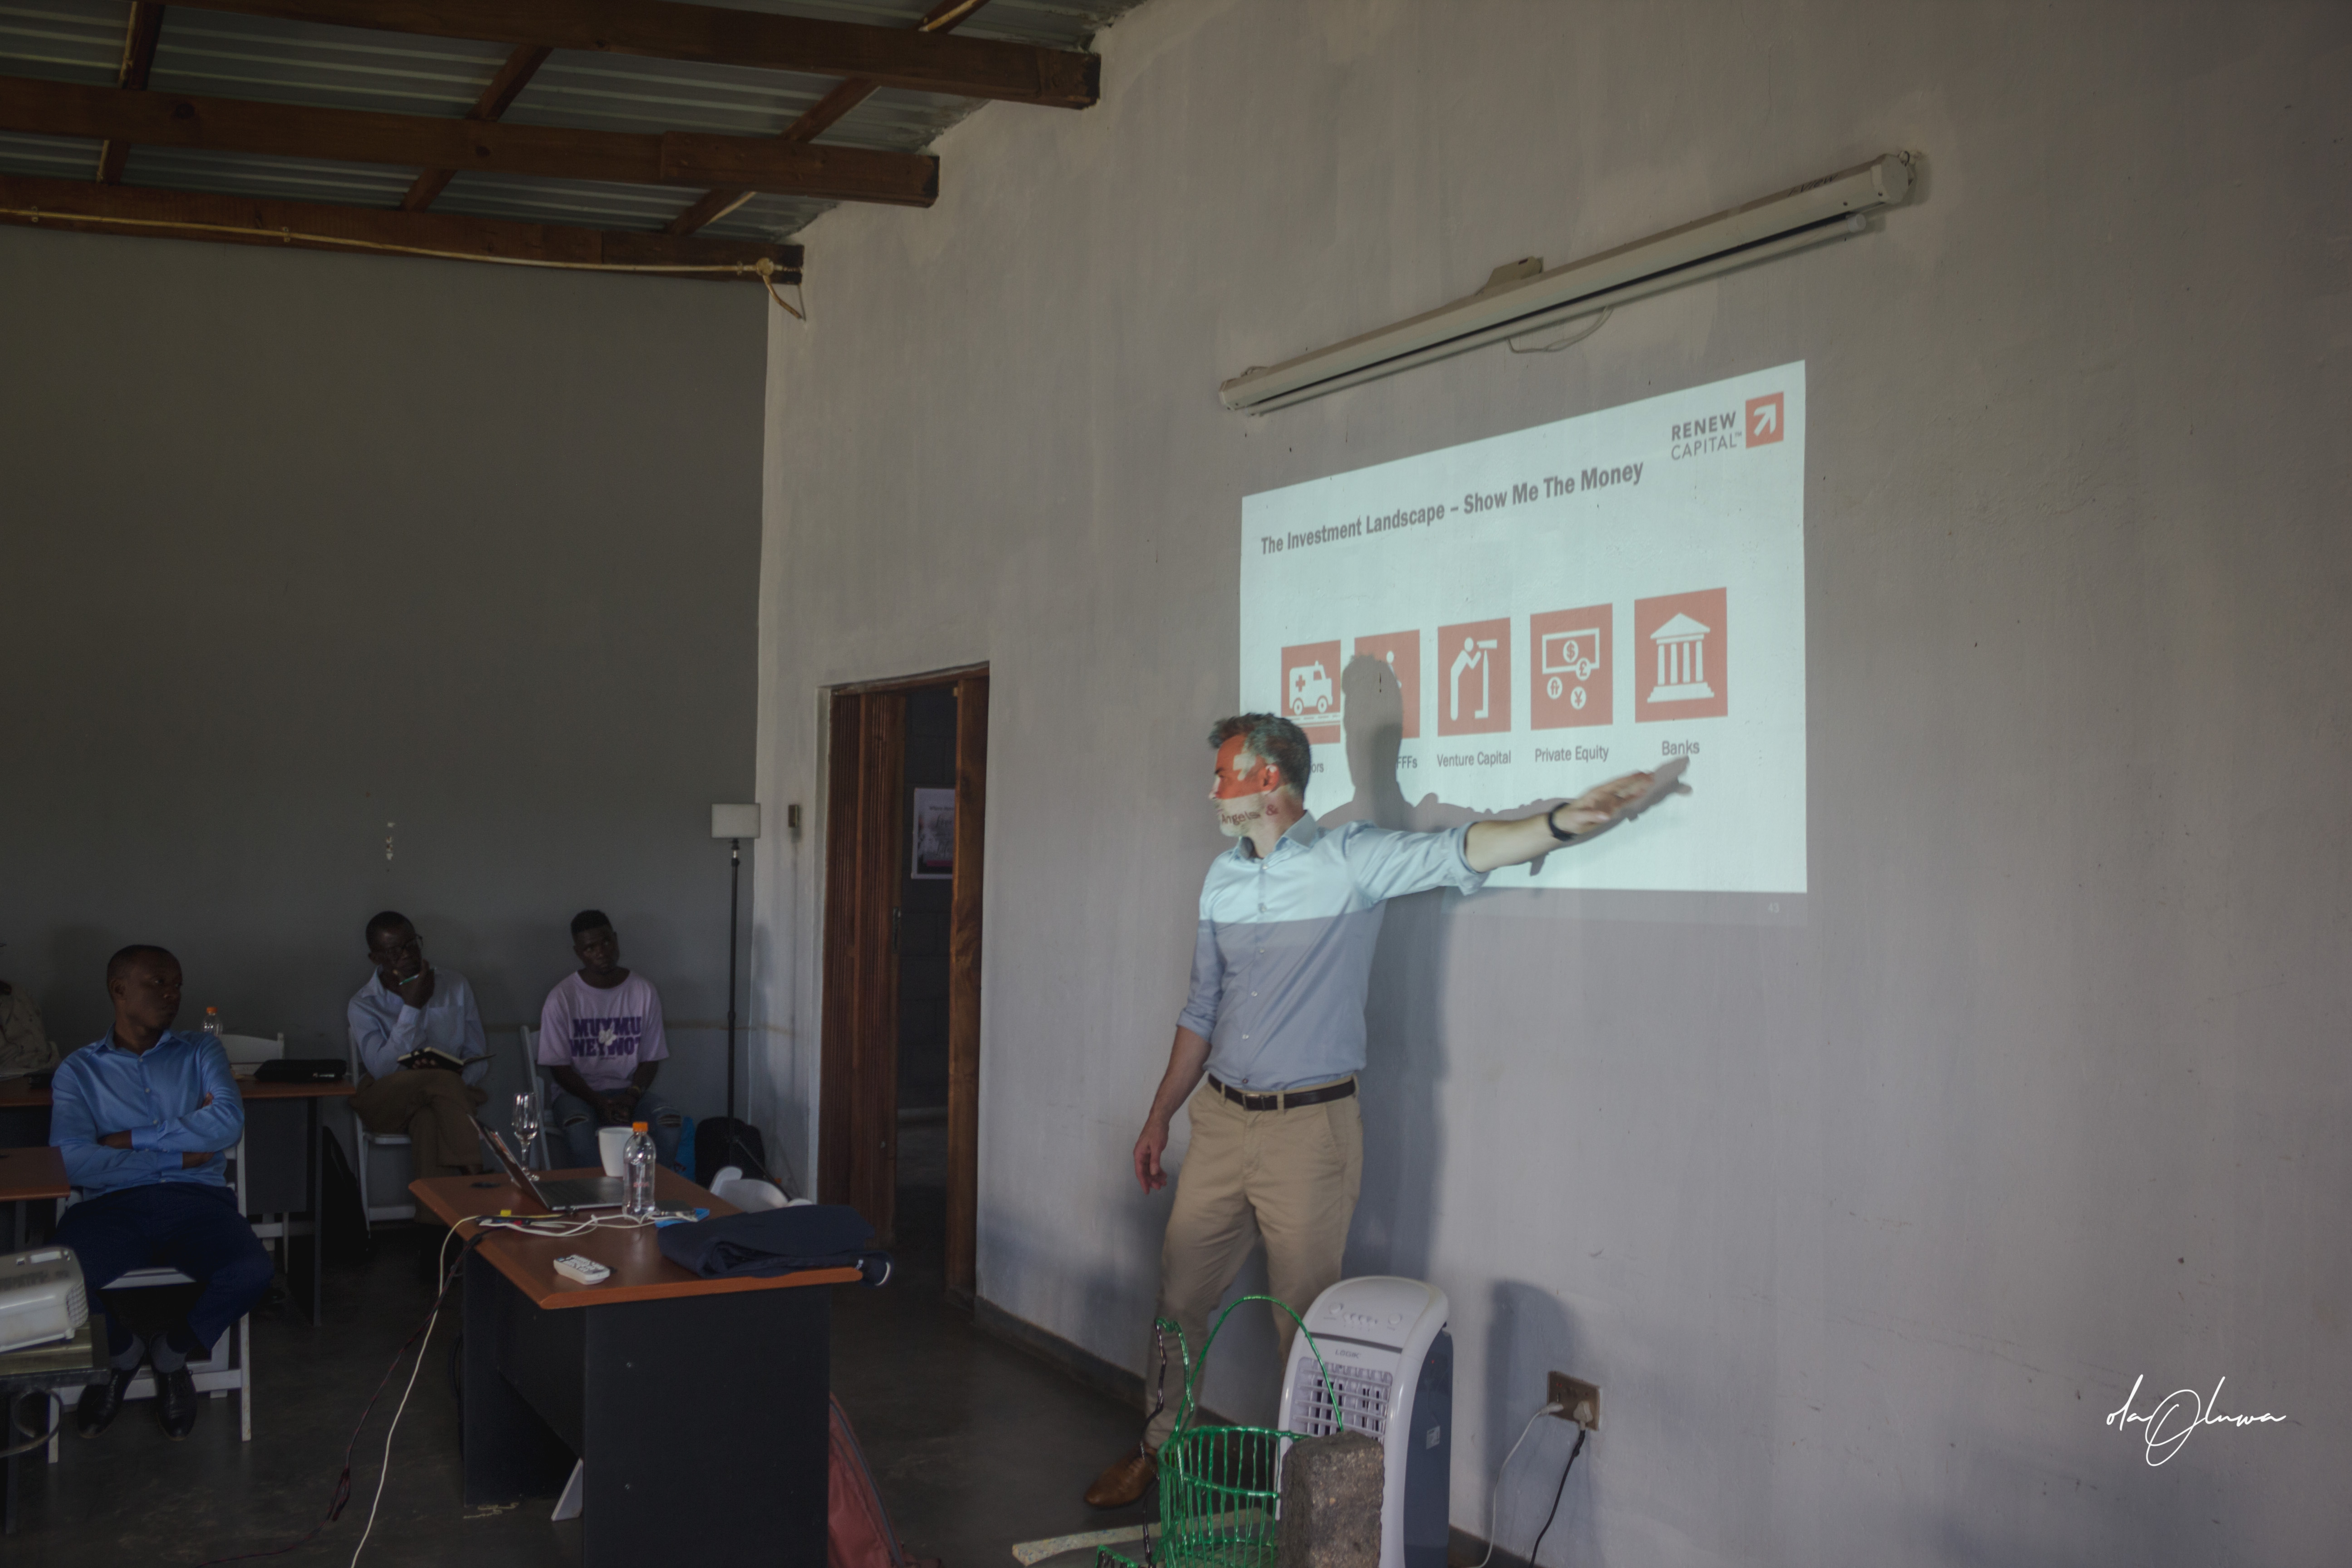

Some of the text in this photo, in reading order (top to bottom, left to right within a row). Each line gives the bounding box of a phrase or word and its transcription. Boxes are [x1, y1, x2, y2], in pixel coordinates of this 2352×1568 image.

[1671, 411, 1736, 441] RENEW
[1261, 536, 1284, 554] The
[1287, 517, 1362, 550] Investment
[1366, 505, 1445, 534] Landscape
[1464, 491, 1508, 514] Show
[1512, 482, 1539, 505] Me
[1544, 475, 1575, 498] The
[1581, 462, 1644, 491] Money
[1535, 745, 1609, 762] Private Equity
[1661, 740, 1700, 756] Banks
[1437, 750, 1512, 767] Venture Capital
[1311, 763, 1324, 773] ors
[1221, 804, 1279, 825] Angels &
[1335, 1349, 1359, 1359] LOGIK
